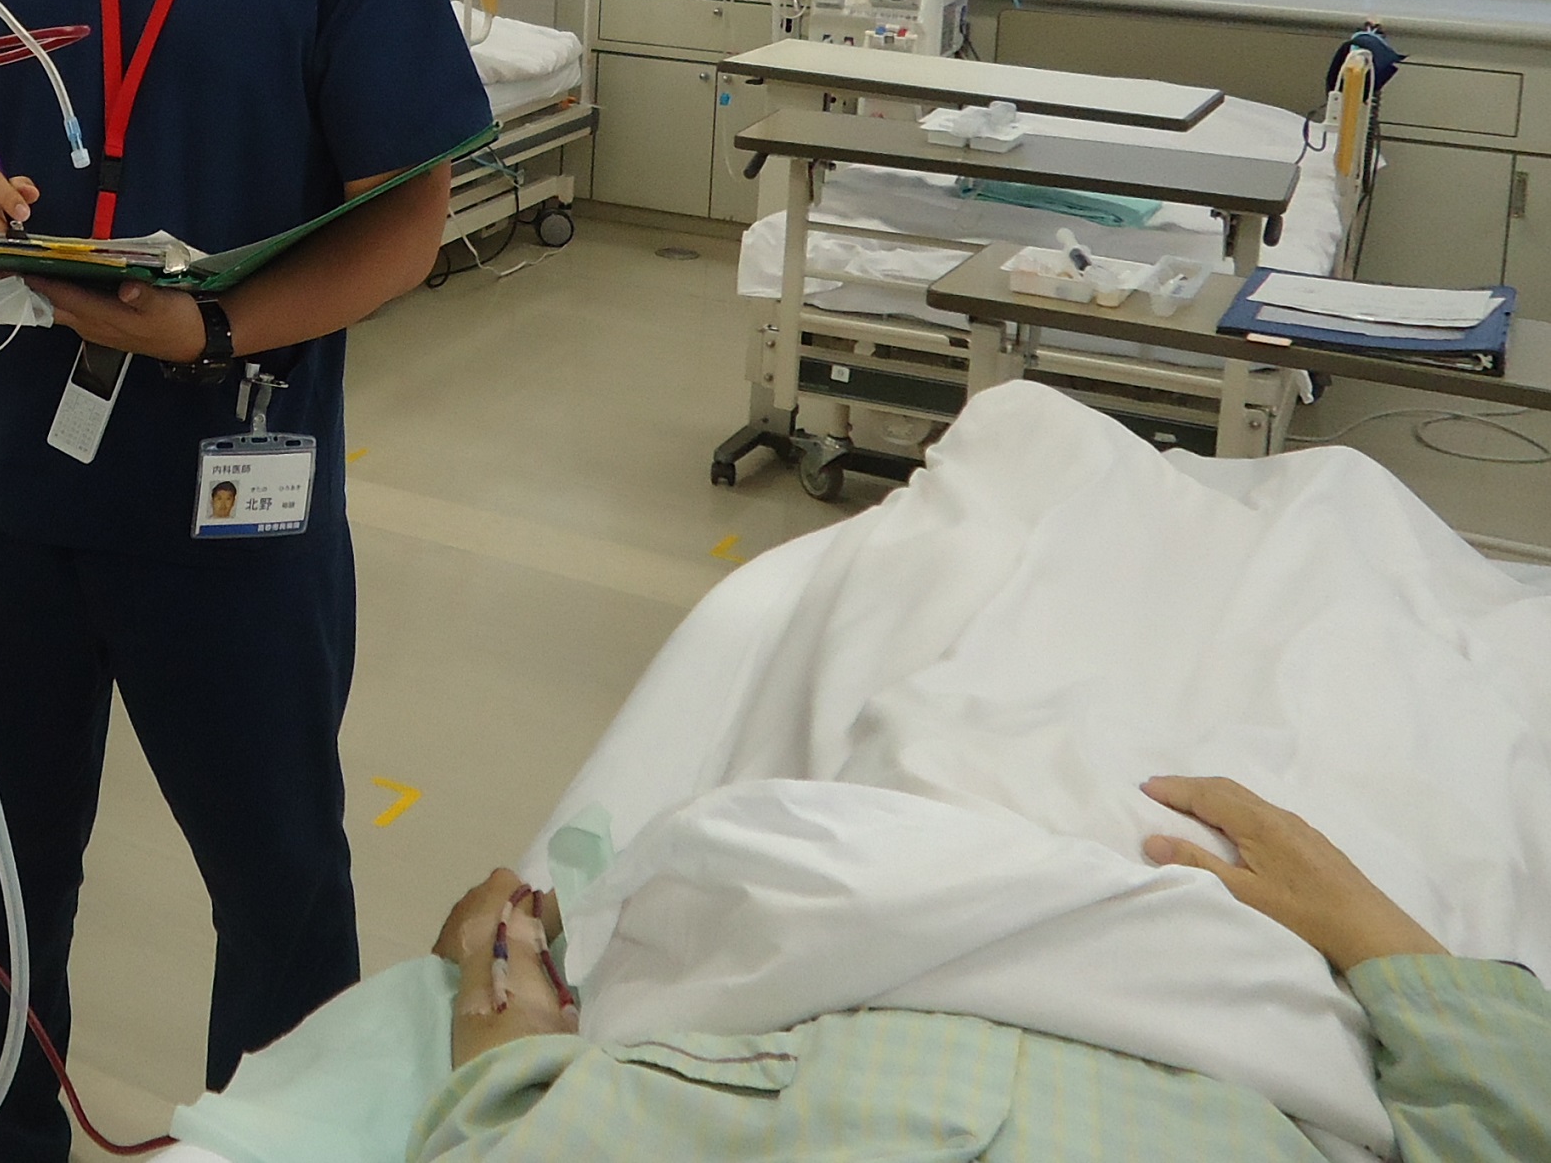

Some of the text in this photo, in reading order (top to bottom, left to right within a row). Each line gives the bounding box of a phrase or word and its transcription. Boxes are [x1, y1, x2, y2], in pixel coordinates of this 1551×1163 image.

[212, 464, 251, 475] 内科医師
[245, 497, 273, 511] 北野
